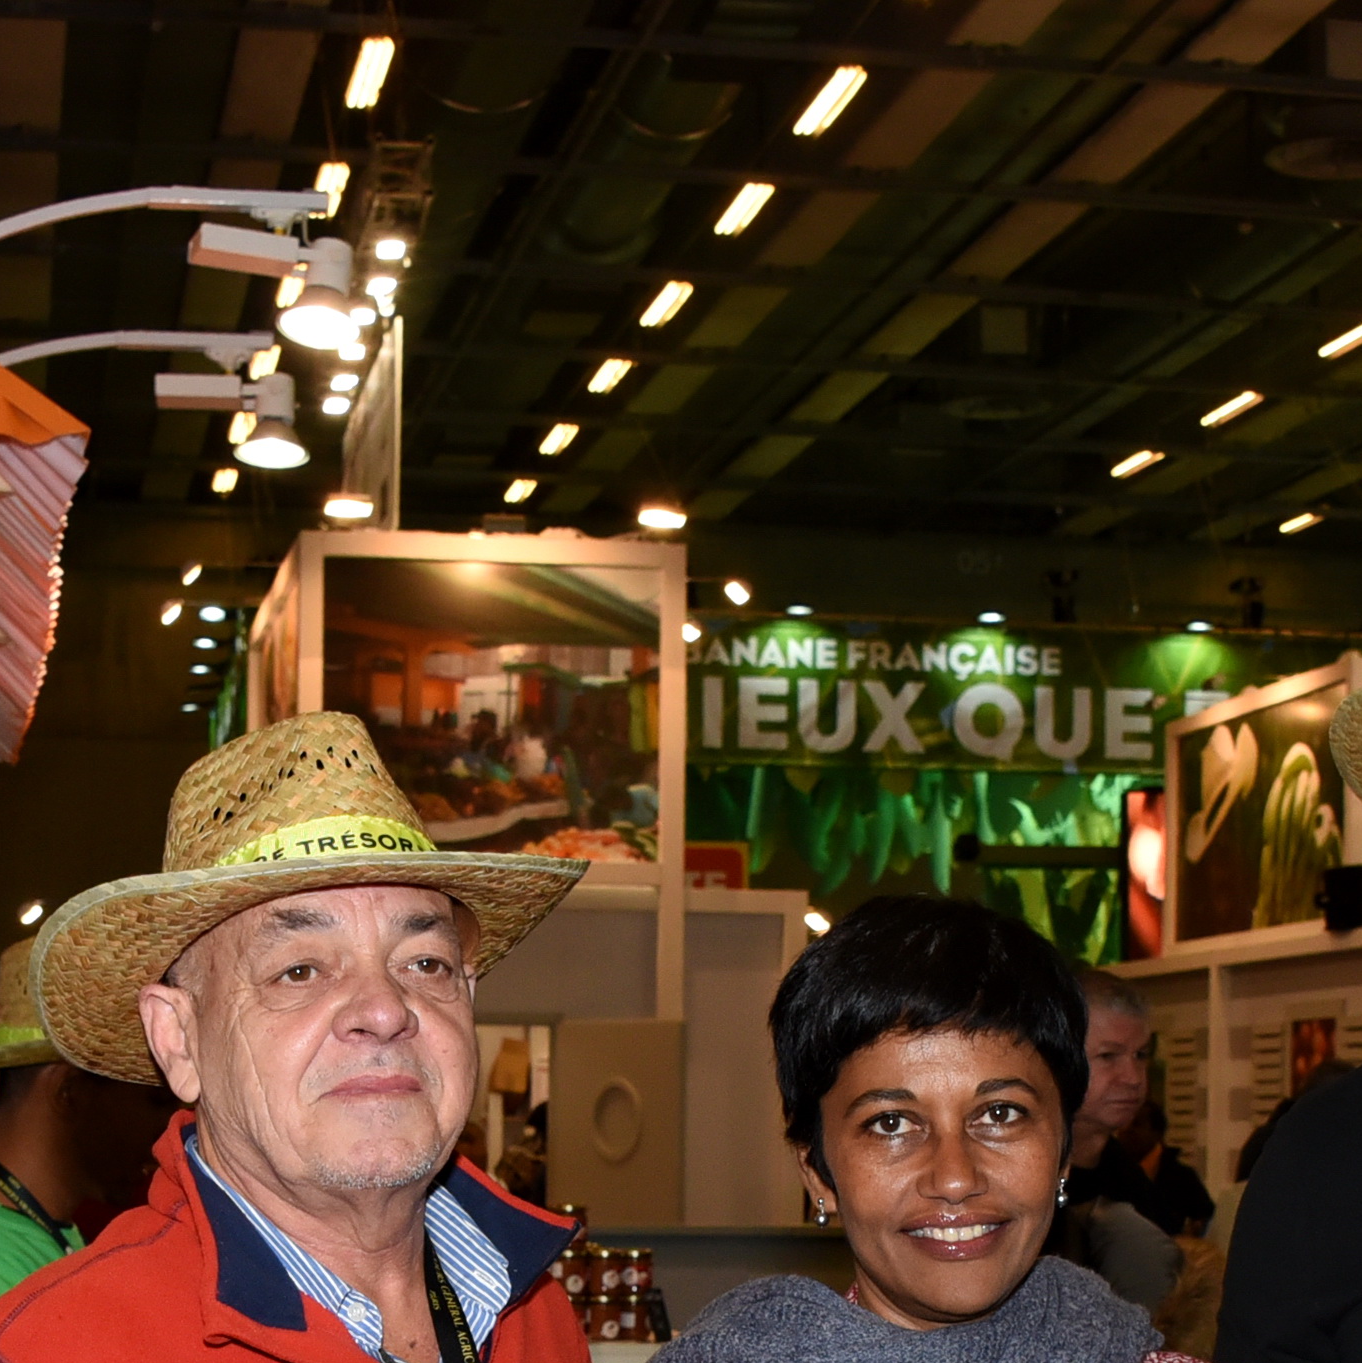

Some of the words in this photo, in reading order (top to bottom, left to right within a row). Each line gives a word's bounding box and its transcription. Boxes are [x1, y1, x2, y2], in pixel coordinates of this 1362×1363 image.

[847, 640, 1061, 681] FRANÇAISE
[702, 676, 927, 755] IEUX
[953, 682, 1154, 762] QUE
[295, 829, 414, 855] TRÉSOR
[440, 1284, 465, 1329] GÉNÉRAL
